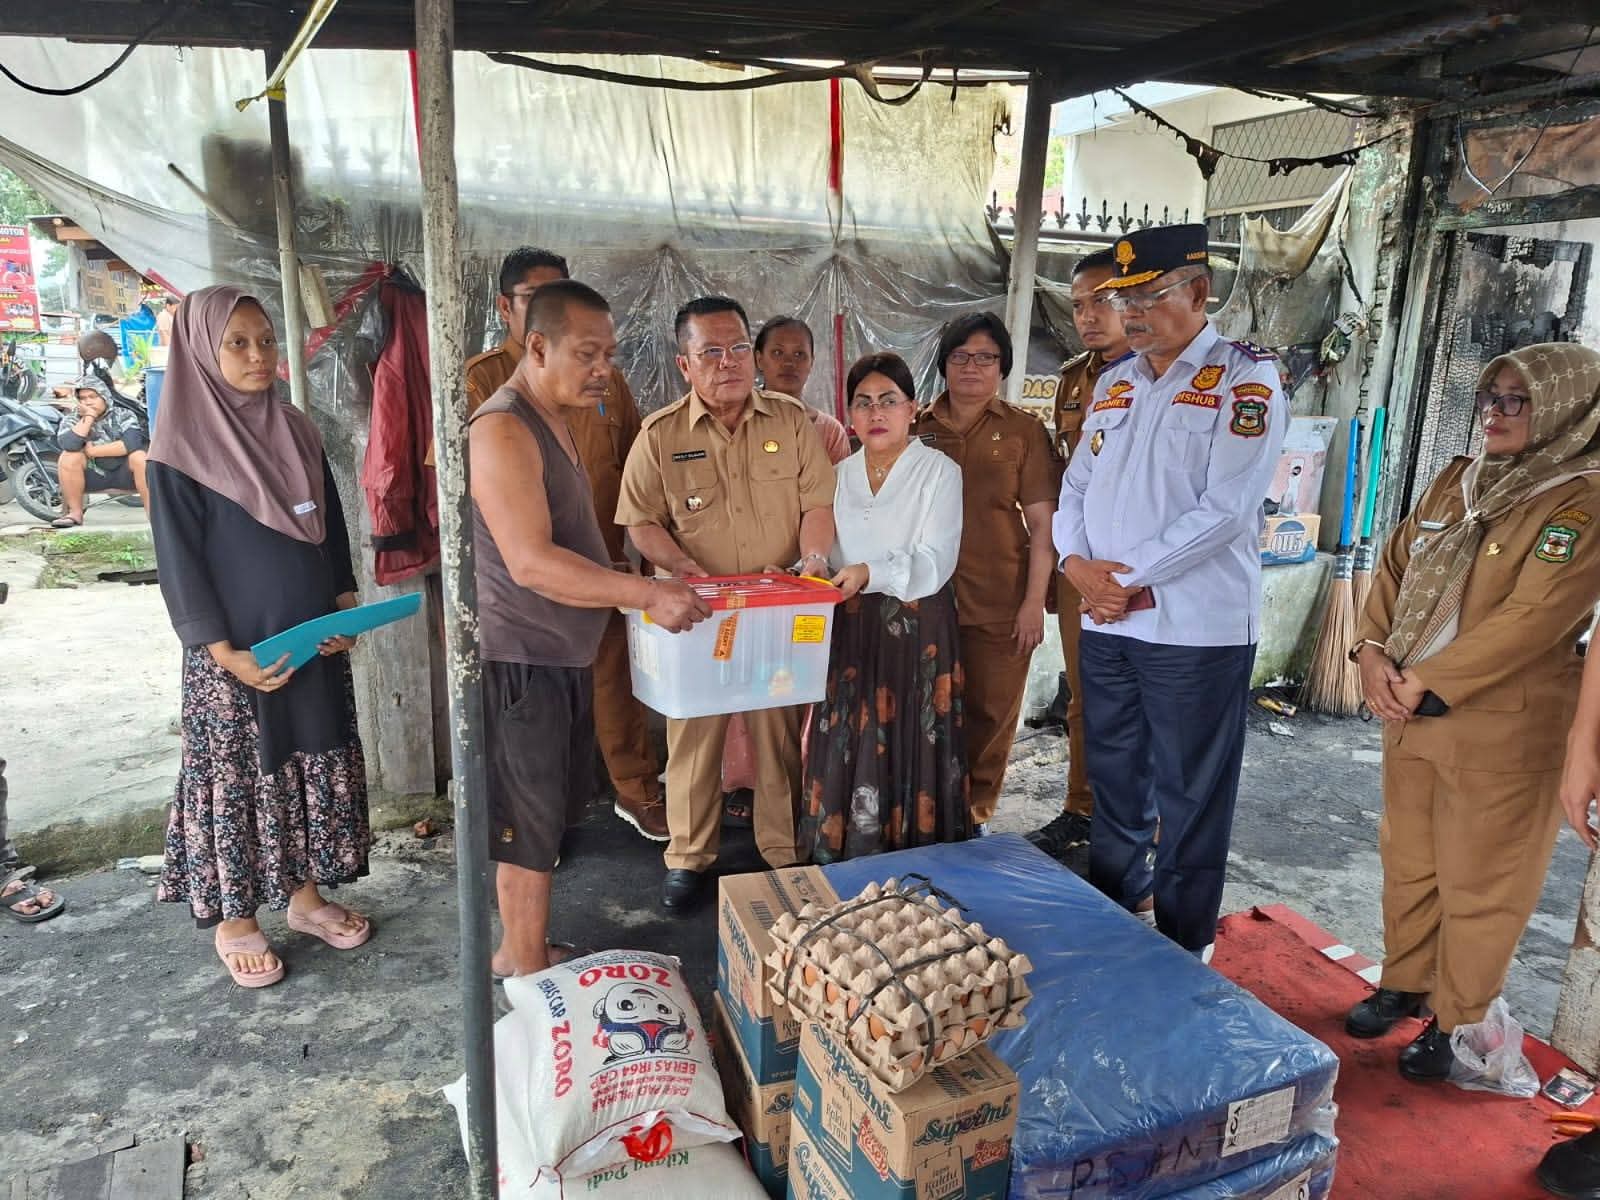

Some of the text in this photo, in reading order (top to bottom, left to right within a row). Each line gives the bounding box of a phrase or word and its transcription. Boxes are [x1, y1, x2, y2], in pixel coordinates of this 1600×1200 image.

[1095, 398, 1127, 410] DANIEL
[578, 964, 673, 988] ZORO
[551, 1020, 574, 1098] ZORO
[622, 1061, 651, 1077] IR64
[655, 1060, 697, 1075] BERAS
[587, 1163, 628, 1192] Padi
